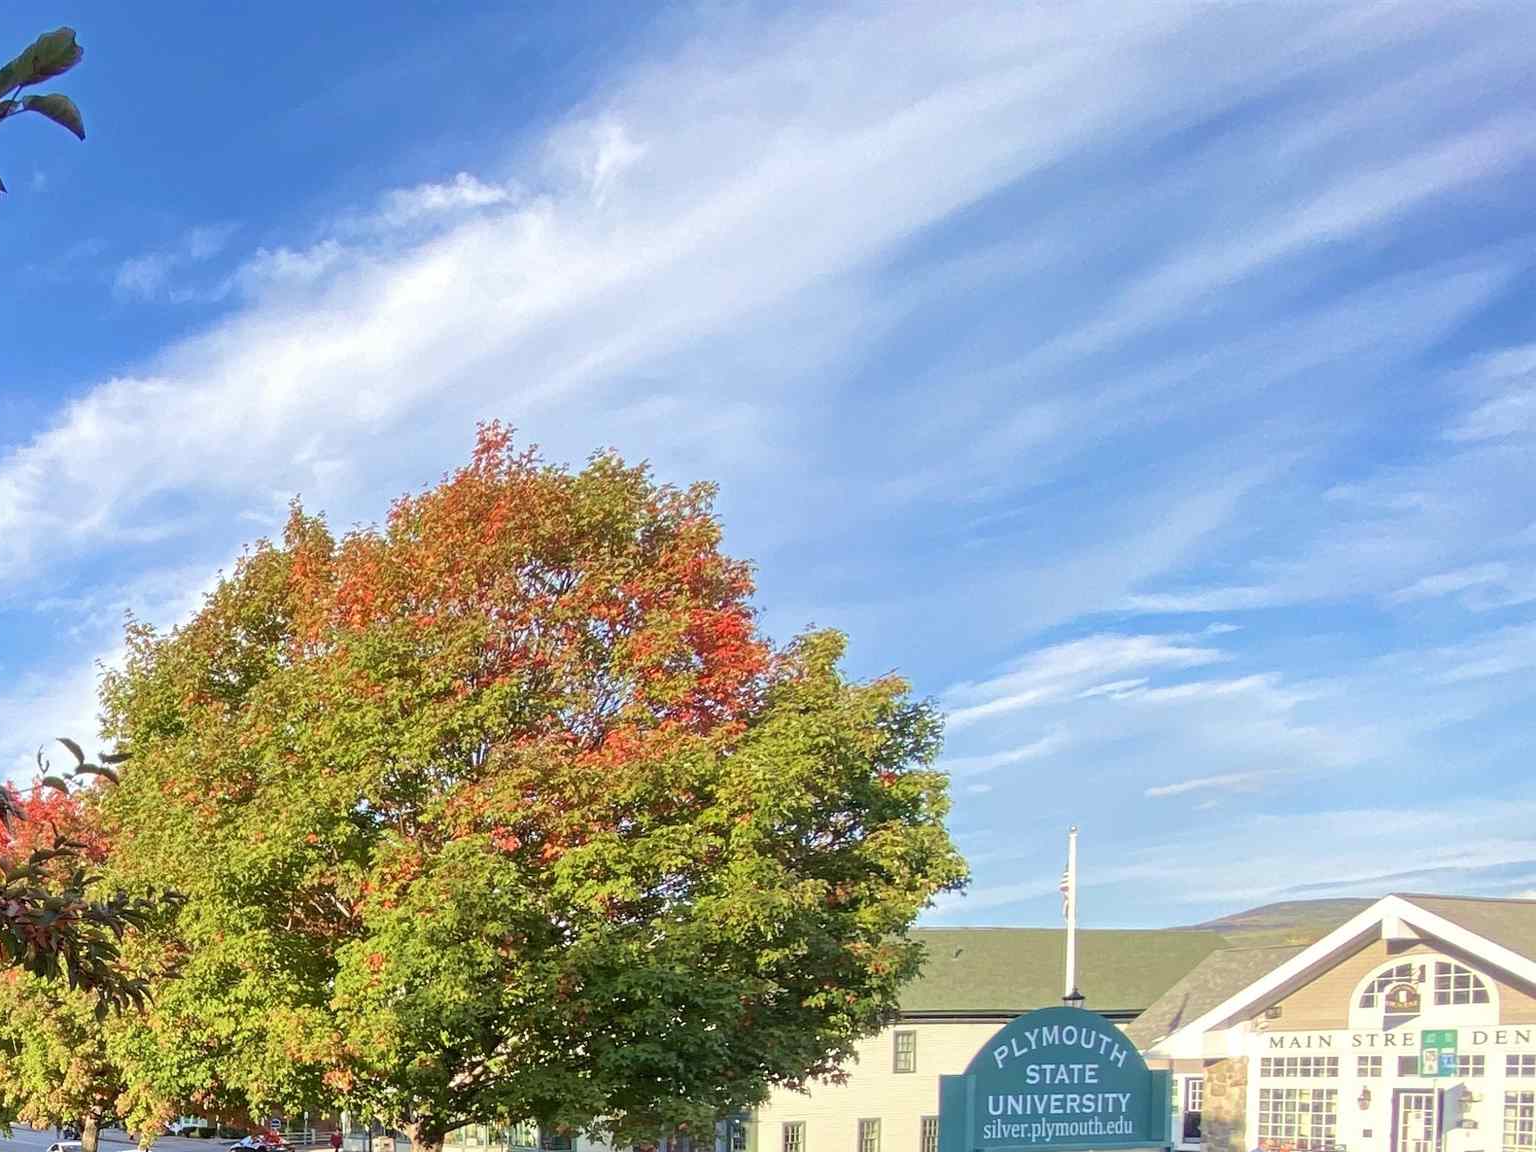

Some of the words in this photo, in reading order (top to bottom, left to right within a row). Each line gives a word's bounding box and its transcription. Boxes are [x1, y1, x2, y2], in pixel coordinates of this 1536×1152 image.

[993, 1025, 1128, 1069] PLYMOUTH
[1269, 1035, 1332, 1049] MAIN
[1352, 1033, 1415, 1047] STRE
[1025, 1064, 1099, 1084] STATE
[988, 1093, 1132, 1115] UNIVERSITY
[983, 1115, 1134, 1142] silver.plymouth.edu
